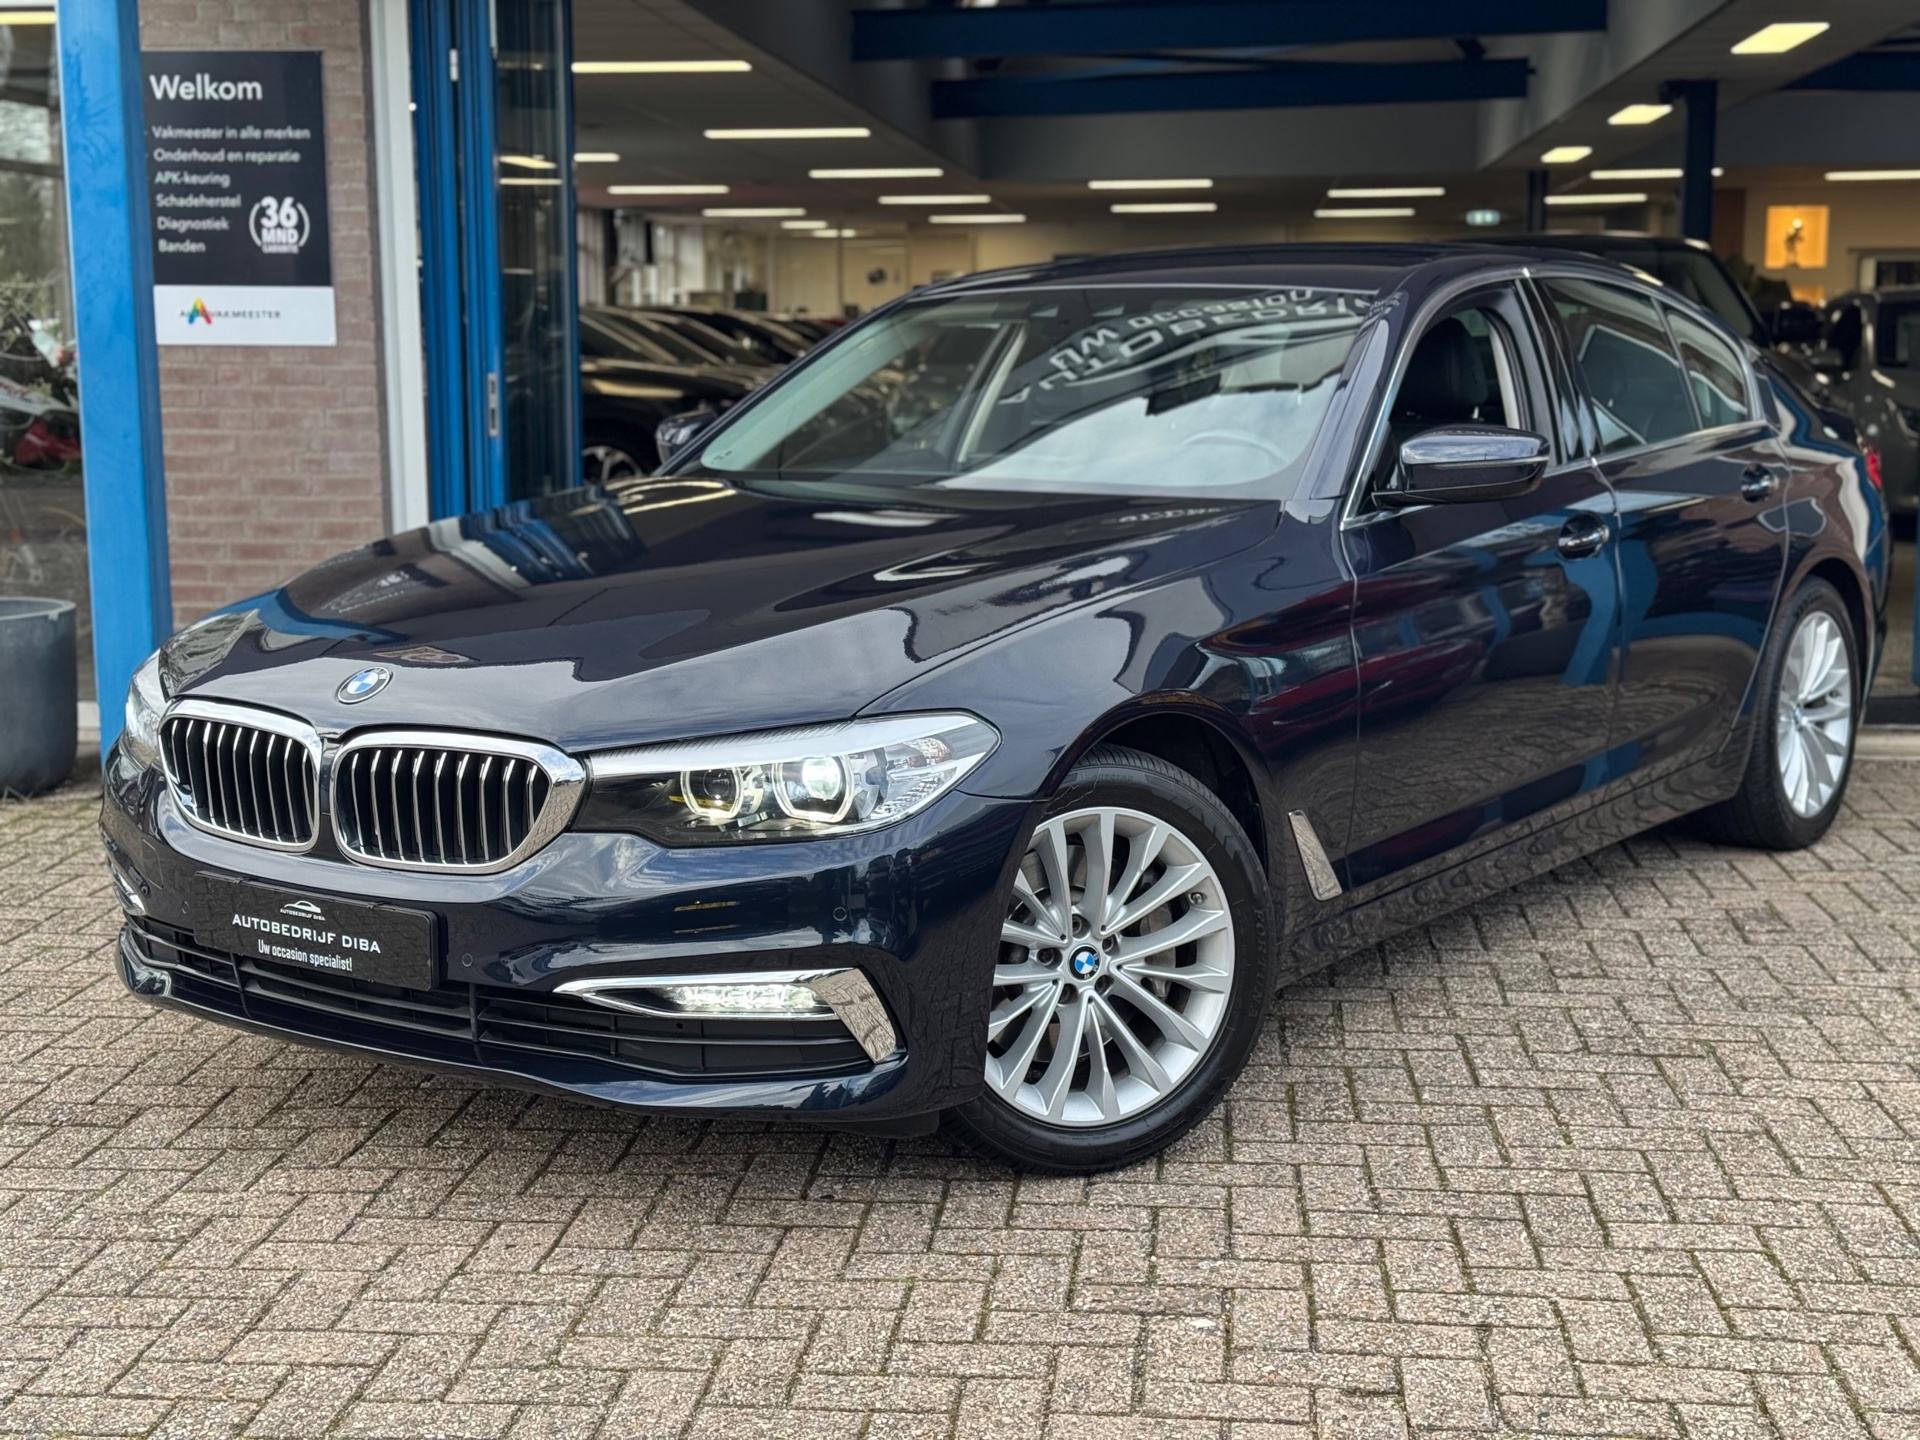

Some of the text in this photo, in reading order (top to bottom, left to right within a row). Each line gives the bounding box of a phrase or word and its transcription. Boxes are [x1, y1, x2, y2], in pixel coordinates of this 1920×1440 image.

[149, 72, 263, 101] Welkom
[152, 125, 311, 140] Vakmeester in alle merken
[153, 147, 301, 166] Onderhoud en reparatie
[155, 171, 231, 188] APK-keuring
[156, 194, 242, 209] Schadeherstel
[260, 196, 299, 228] 36
[157, 216, 230, 233] Diagnostiek
[261, 228, 299, 244] MND
[158, 239, 207, 253] Banden
[232, 913, 381, 954] AUTOBEDRIJF DIBA
[258, 938, 353, 972] Uw occasion specialist!
